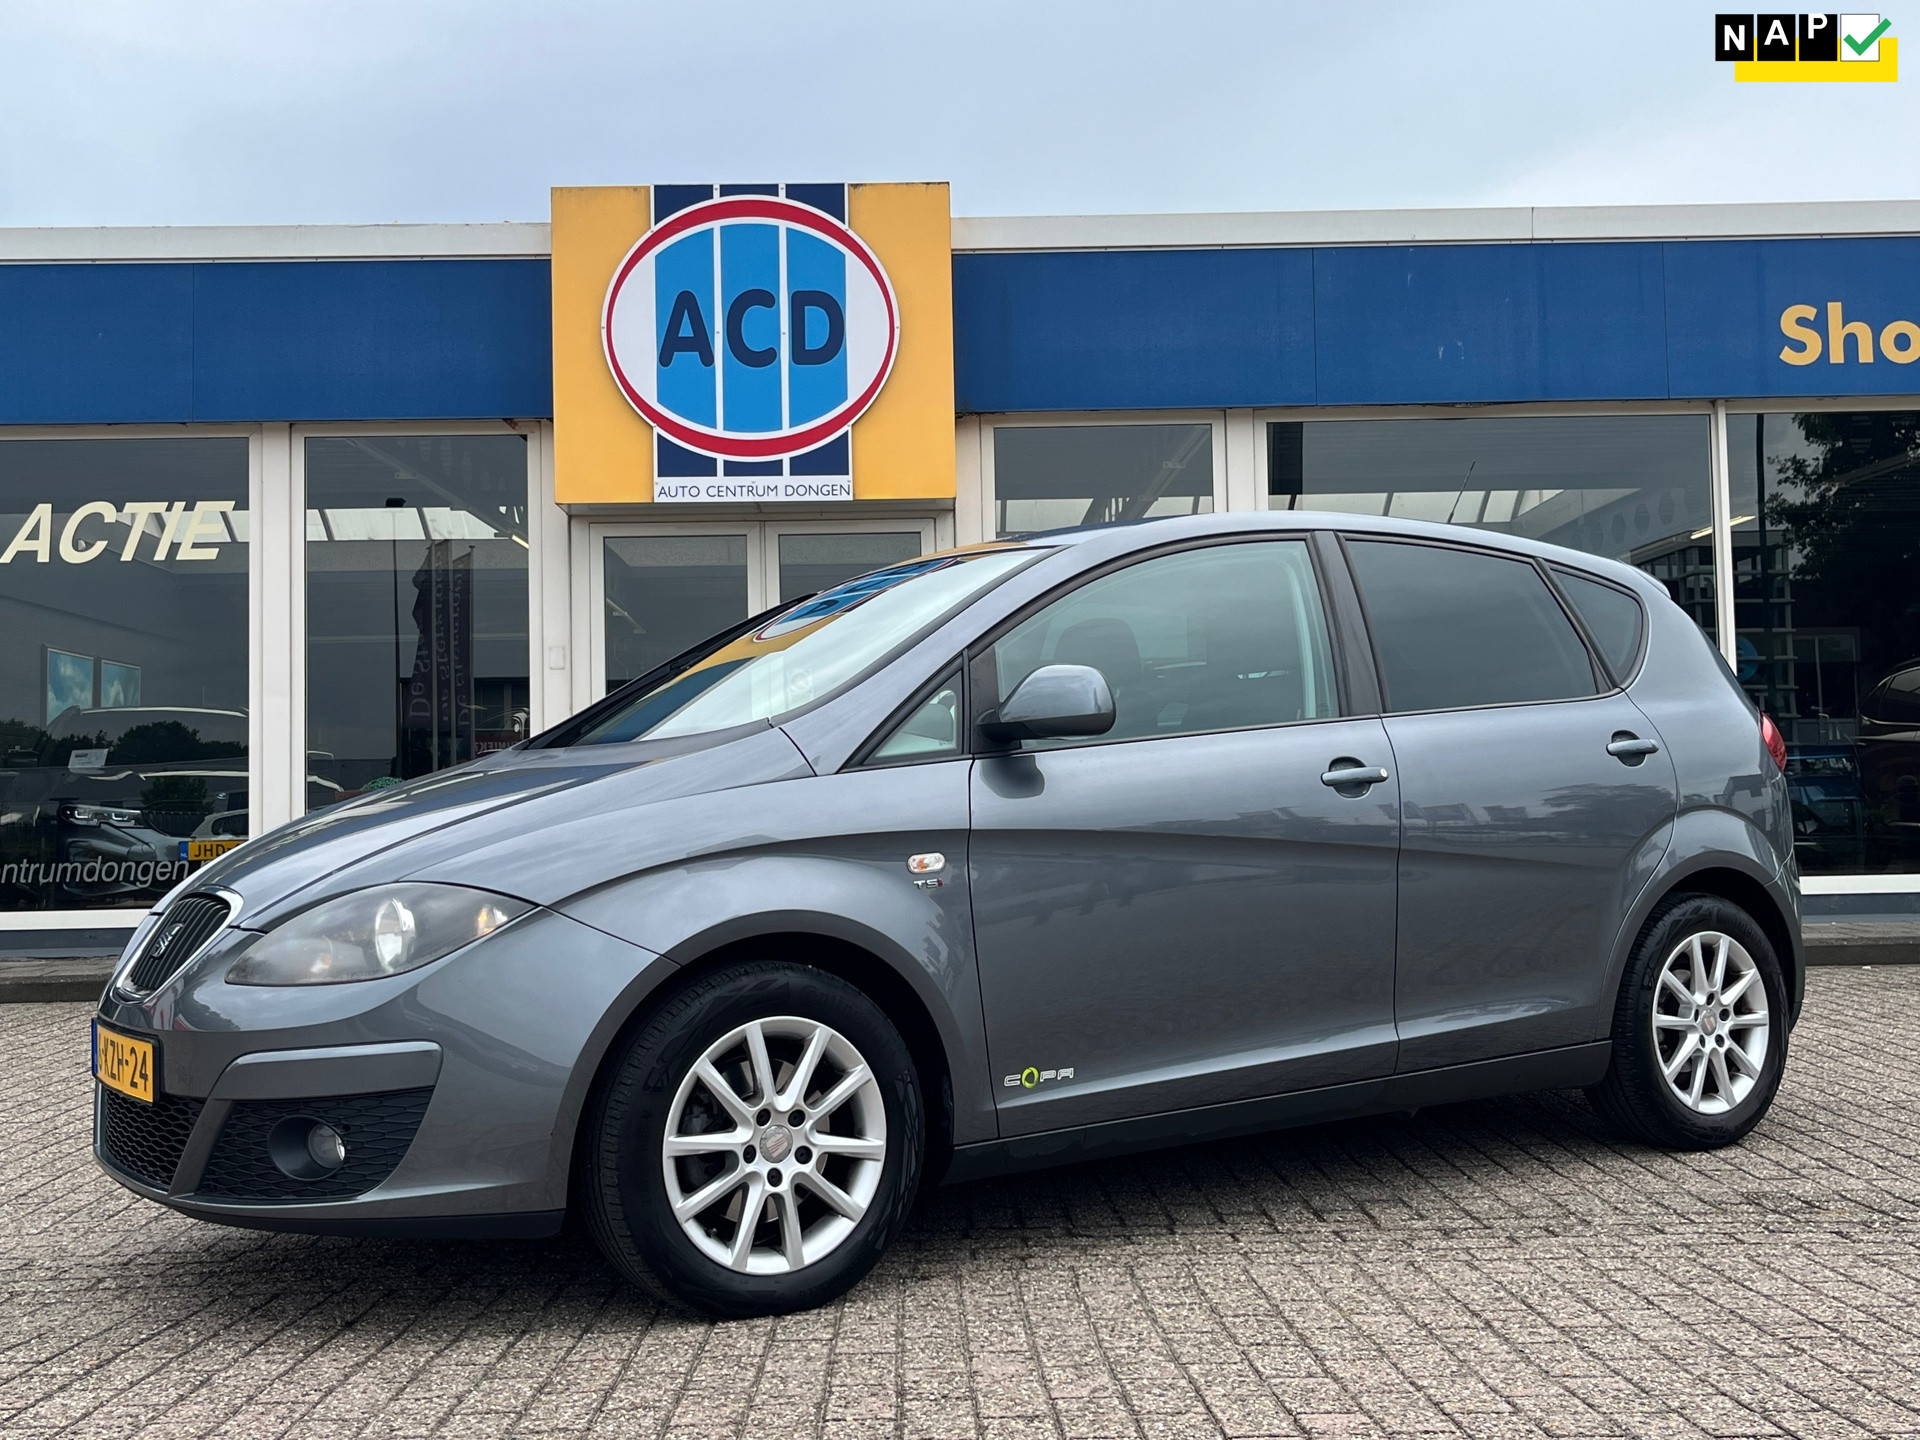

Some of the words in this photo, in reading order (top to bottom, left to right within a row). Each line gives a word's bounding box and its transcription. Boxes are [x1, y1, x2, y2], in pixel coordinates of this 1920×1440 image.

[659, 288, 845, 368] ACD
[1779, 301, 1920, 366] Sho
[658, 485, 700, 498] AUTO
[706, 484, 778, 498] CENTRUM
[784, 484, 851, 497] DONGEN
[0, 501, 235, 564] ACTIE
[194, 843, 240, 858] JHD-
[0, 856, 212, 888] ntrumdongen
[1003, 1067, 1075, 1089] COPA
